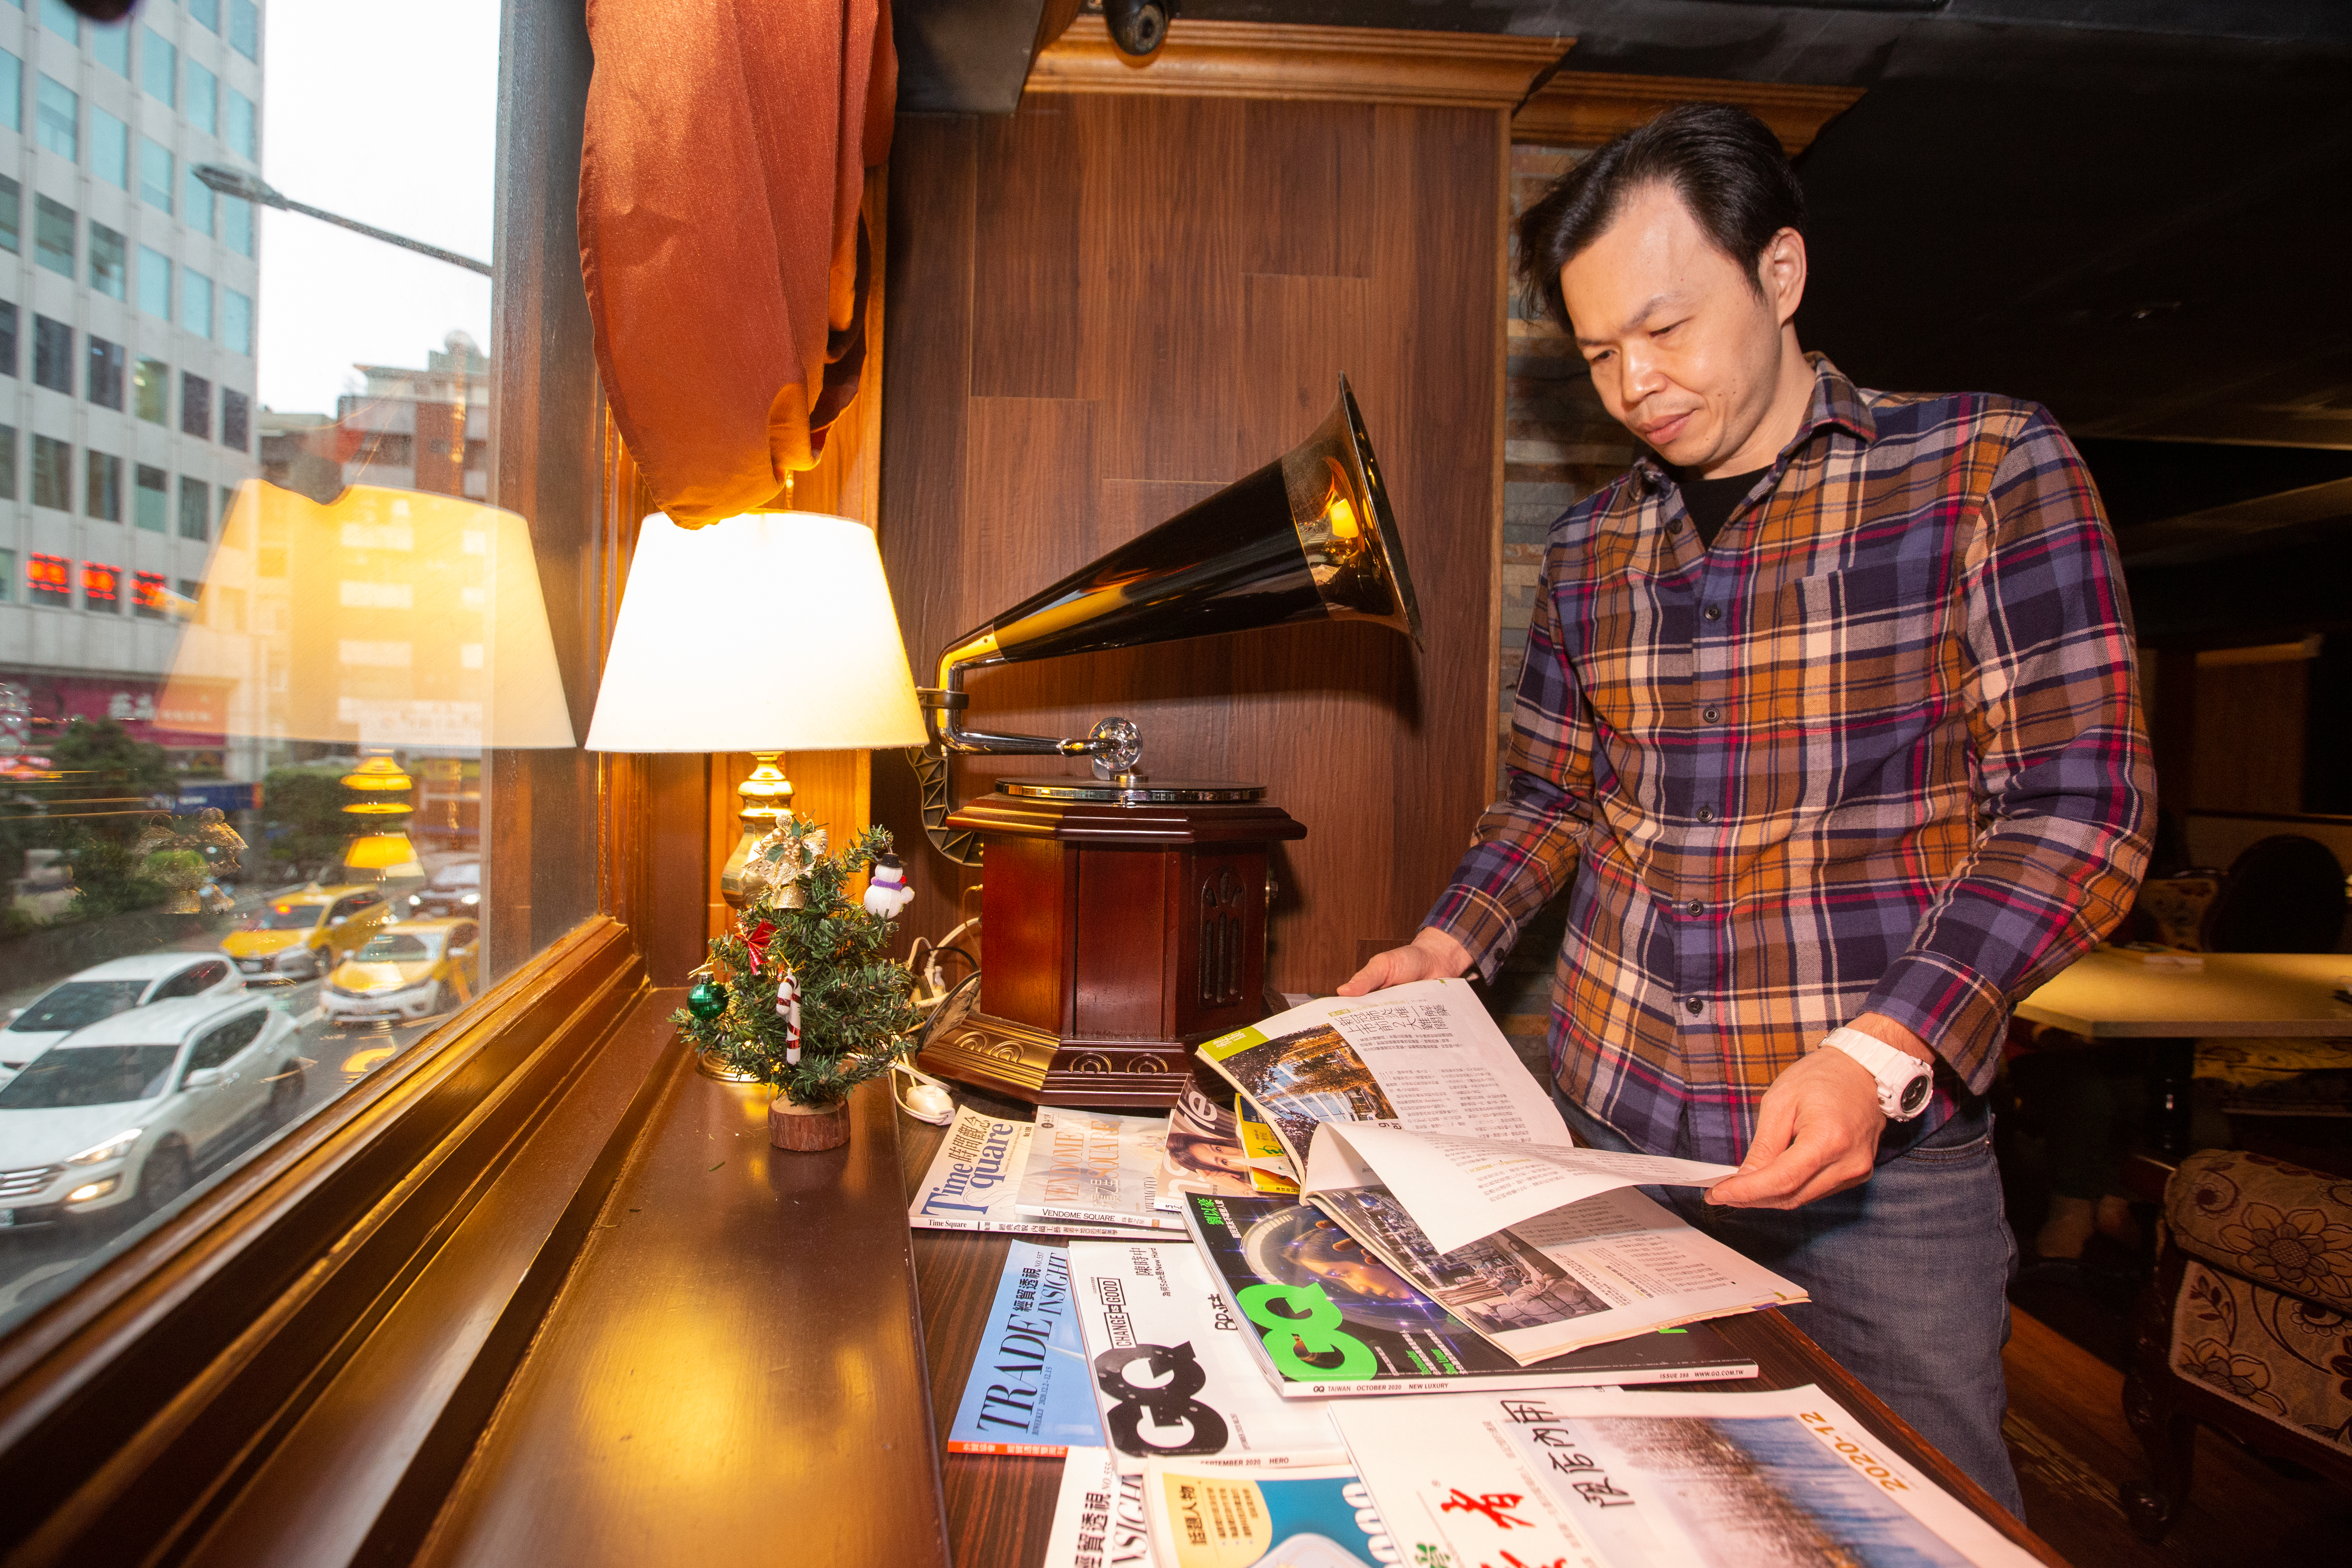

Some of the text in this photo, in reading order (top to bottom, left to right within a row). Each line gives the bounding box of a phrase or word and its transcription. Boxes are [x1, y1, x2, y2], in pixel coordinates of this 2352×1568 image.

[1334, 1004, 1451, 1027] 新冠肺炎唯一解藥
[1348, 1017, 1448, 1035] 上市前2大難關
[948, 1116, 991, 1163] 時間觀念
[1023, 1126, 1032, 1137] No.188
[1044, 1121, 1119, 1203] VENDOME SQUARE
[920, 1163, 989, 1216] Time
[945, 1220, 967, 1228] Square
[1043, 1208, 1115, 1222] VENDOME SQUARE
[1197, 1198, 1224, 1225] 劉以豪
[1129, 1247, 1154, 1276] 陳時中
[1148, 1247, 1159, 1258] Hard
[1012, 1268, 1041, 1312] 經貿透視
[1103, 1281, 1121, 1303] GOOD
[977, 1252, 1068, 1433] TRADE INSIGHT
[1110, 1315, 1132, 1346] CHANGE
[1236, 1281, 1377, 1382] GQ
[1694, 1370, 1744, 1378] WWW.GQ.COM.TW
[1094, 1341, 1228, 1458] GQ
[1500, 1400, 1635, 1508] 限店內用
[1800, 1411, 1910, 1492] 2020-12
